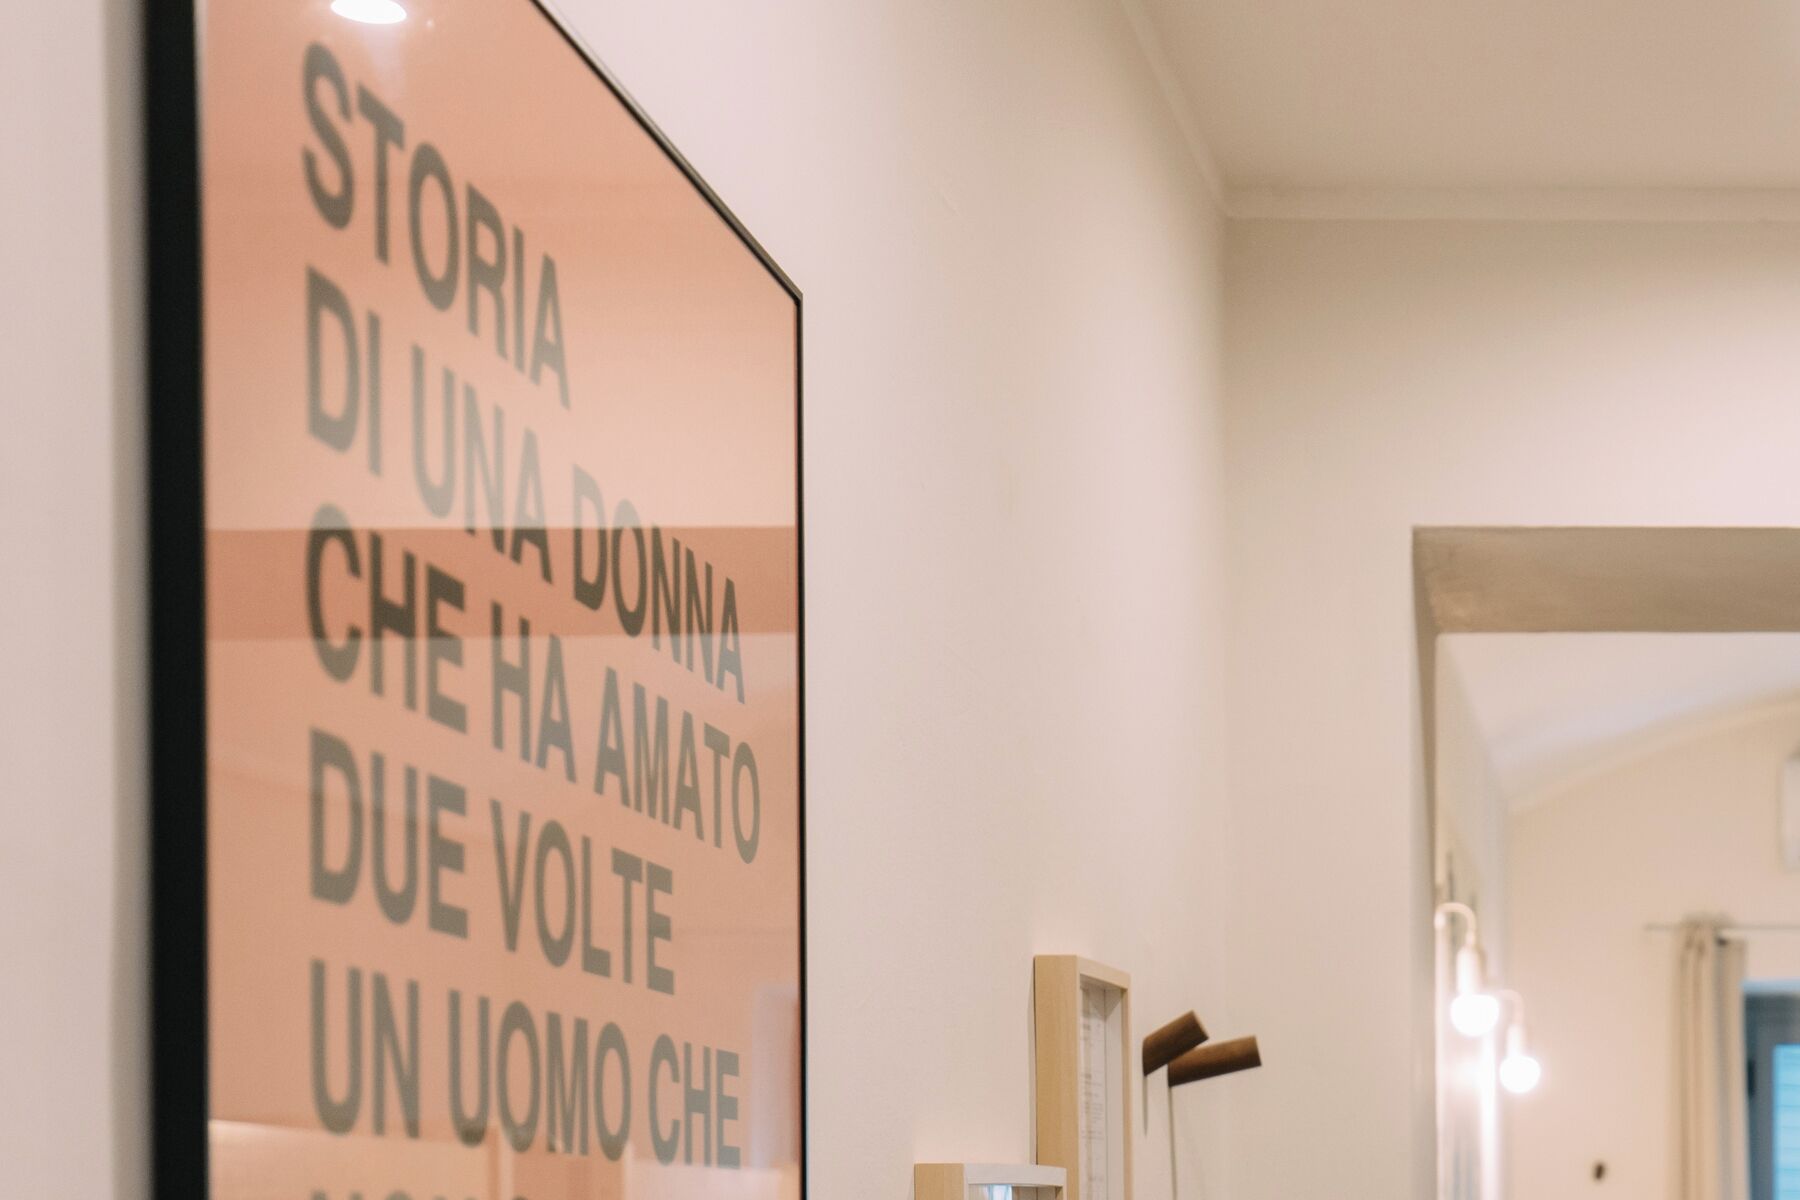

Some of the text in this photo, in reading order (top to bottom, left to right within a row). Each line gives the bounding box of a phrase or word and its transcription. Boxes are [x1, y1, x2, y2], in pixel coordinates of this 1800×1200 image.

[302, 41, 570, 410] STORIA
[305, 264, 746, 705] DI UNA DONNA
[305, 502, 762, 865] CHE HA AMATO
[309, 727, 676, 996] DUE VOLTE
[310, 958, 741, 1170] UN UOMO CHE
